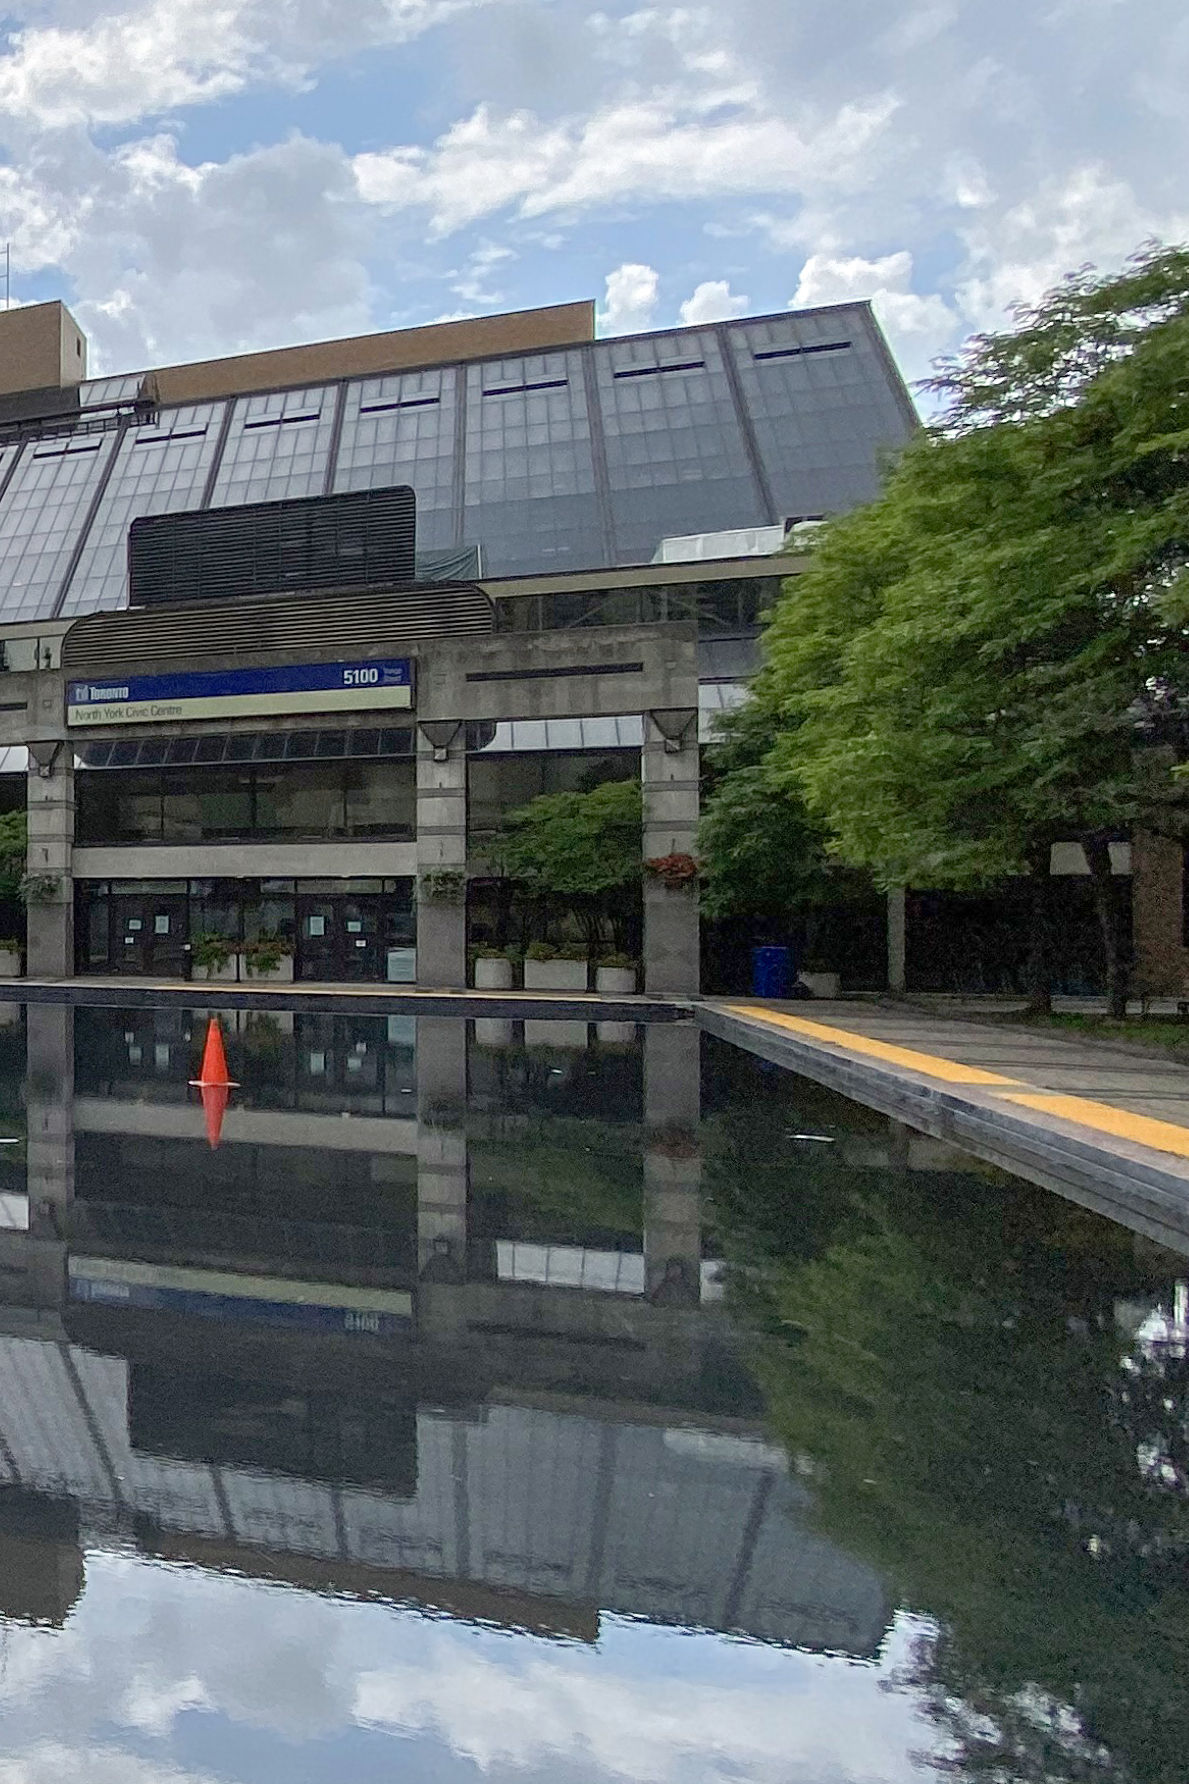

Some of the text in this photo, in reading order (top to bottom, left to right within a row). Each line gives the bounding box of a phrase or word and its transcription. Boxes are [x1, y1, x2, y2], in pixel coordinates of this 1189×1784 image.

[343, 668, 378, 685] 5100
[75, 705, 182, 720] North York Civic Centre
